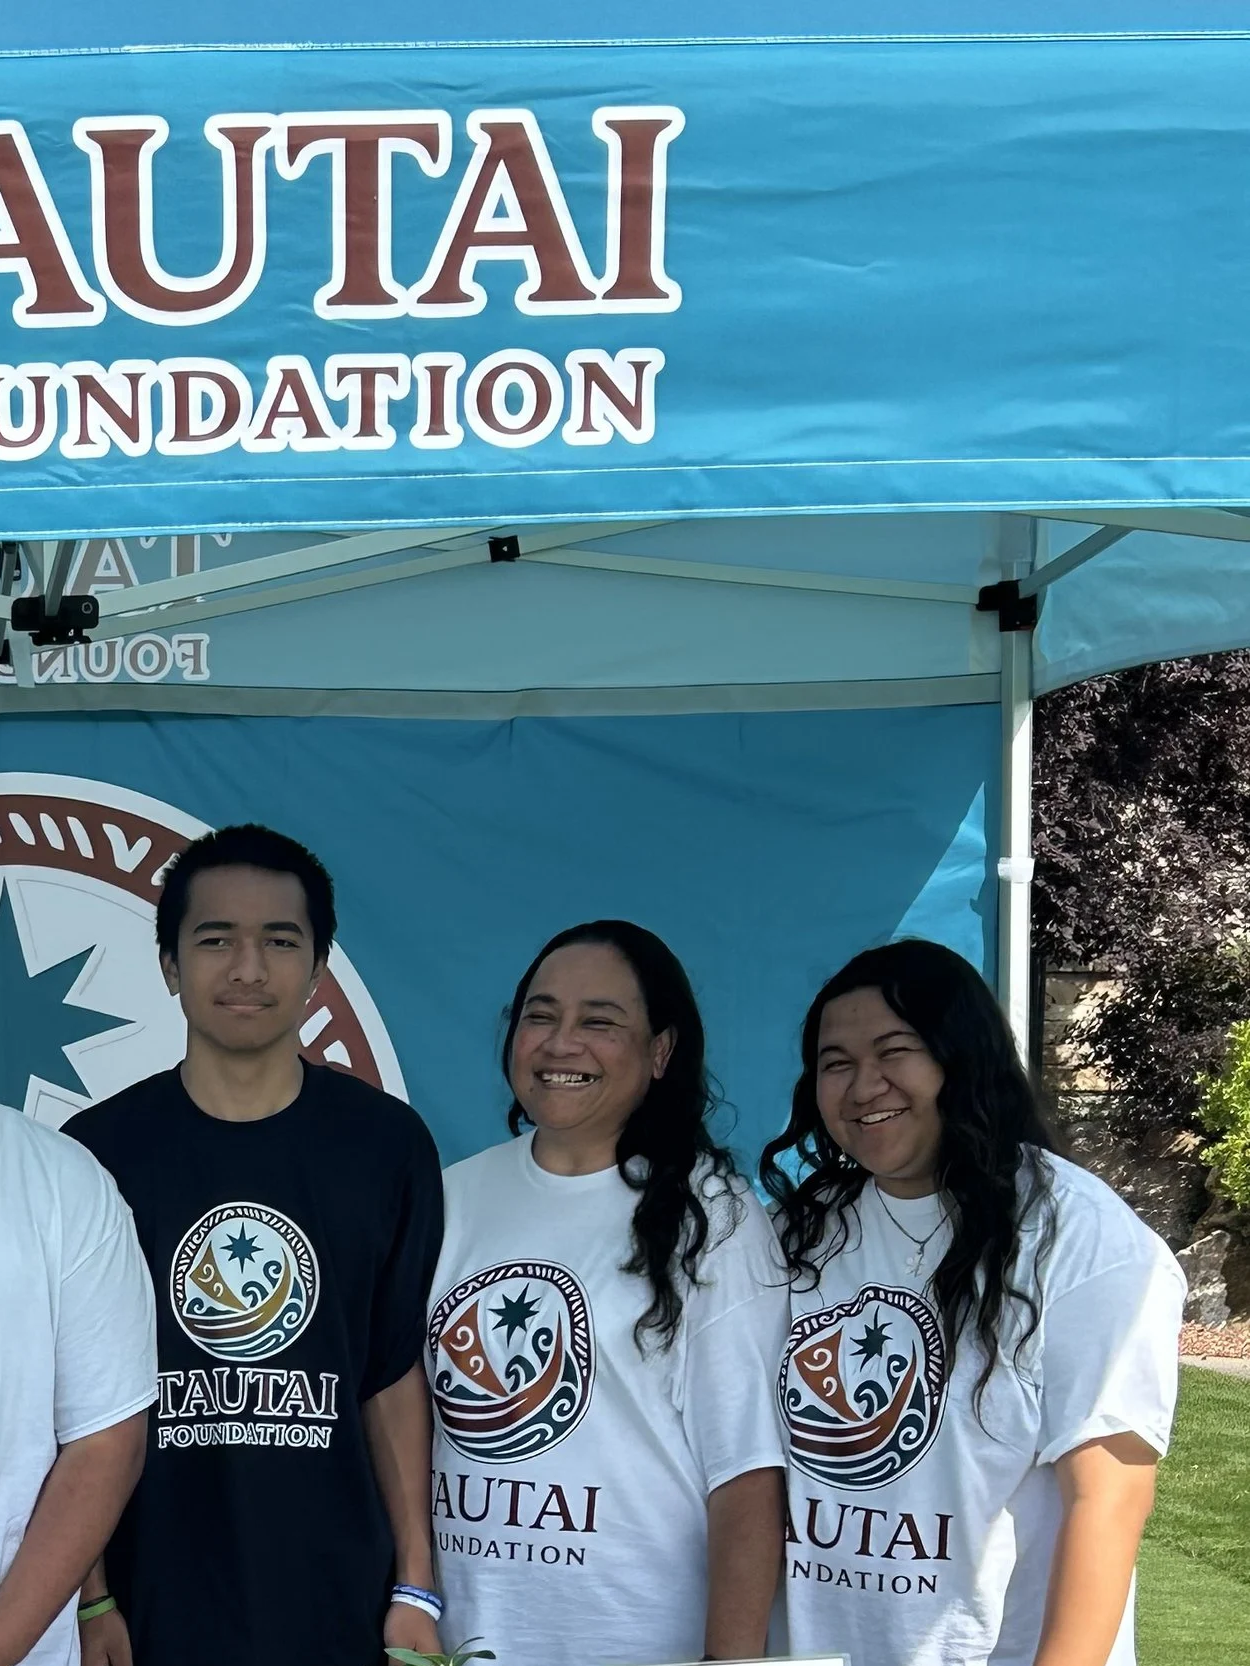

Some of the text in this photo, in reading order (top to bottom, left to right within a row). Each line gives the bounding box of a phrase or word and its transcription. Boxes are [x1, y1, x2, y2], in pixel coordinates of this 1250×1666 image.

[158, 1367, 339, 1419] TAUTAI
[158, 1422, 332, 1448] FOUNDATION
[430, 1469, 602, 1532] AUTAI
[439, 1532, 586, 1566] UNDATION
